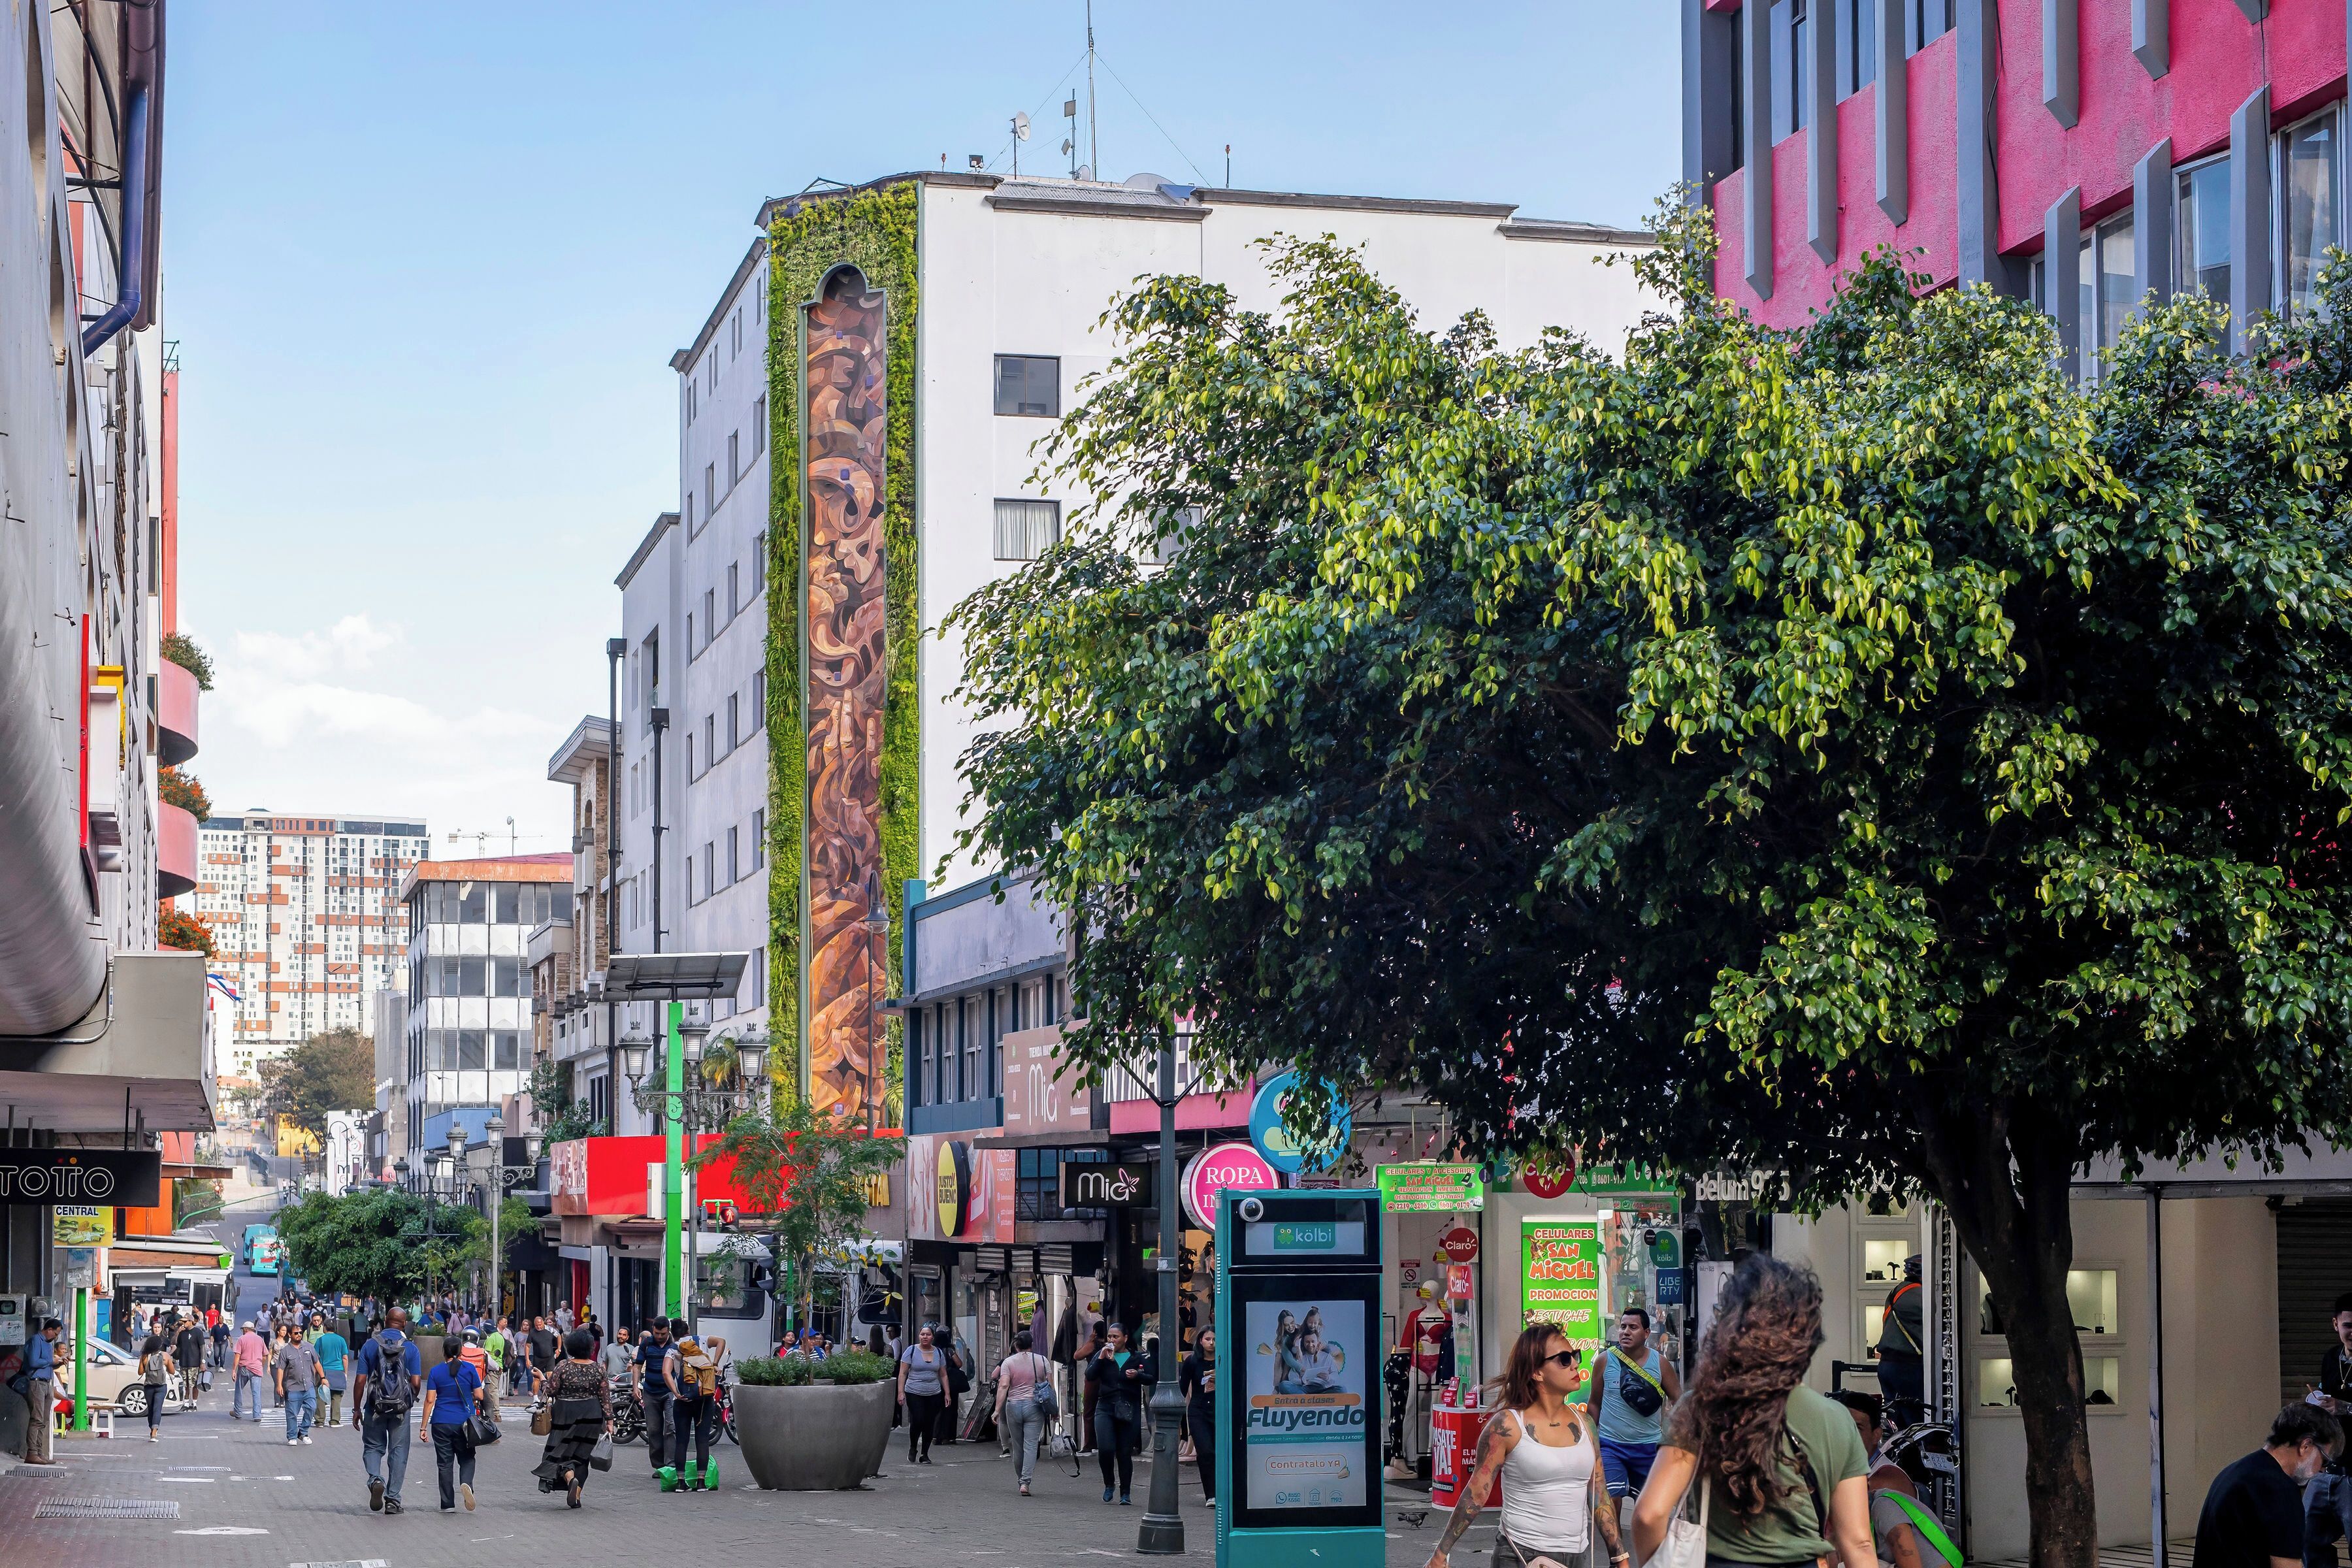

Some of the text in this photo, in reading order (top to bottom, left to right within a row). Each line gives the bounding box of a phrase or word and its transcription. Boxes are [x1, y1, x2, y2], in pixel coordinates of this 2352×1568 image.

[0, 1166, 114, 1198] TOTTO
[939, 1175, 951, 1187] JUSTO
[1205, 1167, 1264, 1184] ROPA
[1406, 1175, 1423, 1186] SAN
[1078, 1172, 1130, 1202] Mia
[1695, 1169, 1791, 1201] Belum 95
[939, 1189, 956, 1203] BUENO
[56, 1207, 99, 1216] CENTRAL
[1296, 1227, 1333, 1243] kölbi
[1534, 1229, 1594, 1239] CELULARES
[1446, 1239, 1473, 1250] Claro
[1547, 1243, 1580, 1258] SAN
[1450, 1274, 1467, 1293] Claro
[1659, 1277, 1681, 1286] LIBE
[1529, 1289, 1598, 1300] PROMOCION
[1660, 1286, 1680, 1295] RTY
[1535, 1309, 1592, 1322] ESTUCHE
[1247, 1405, 1365, 1431] Fluyendo
